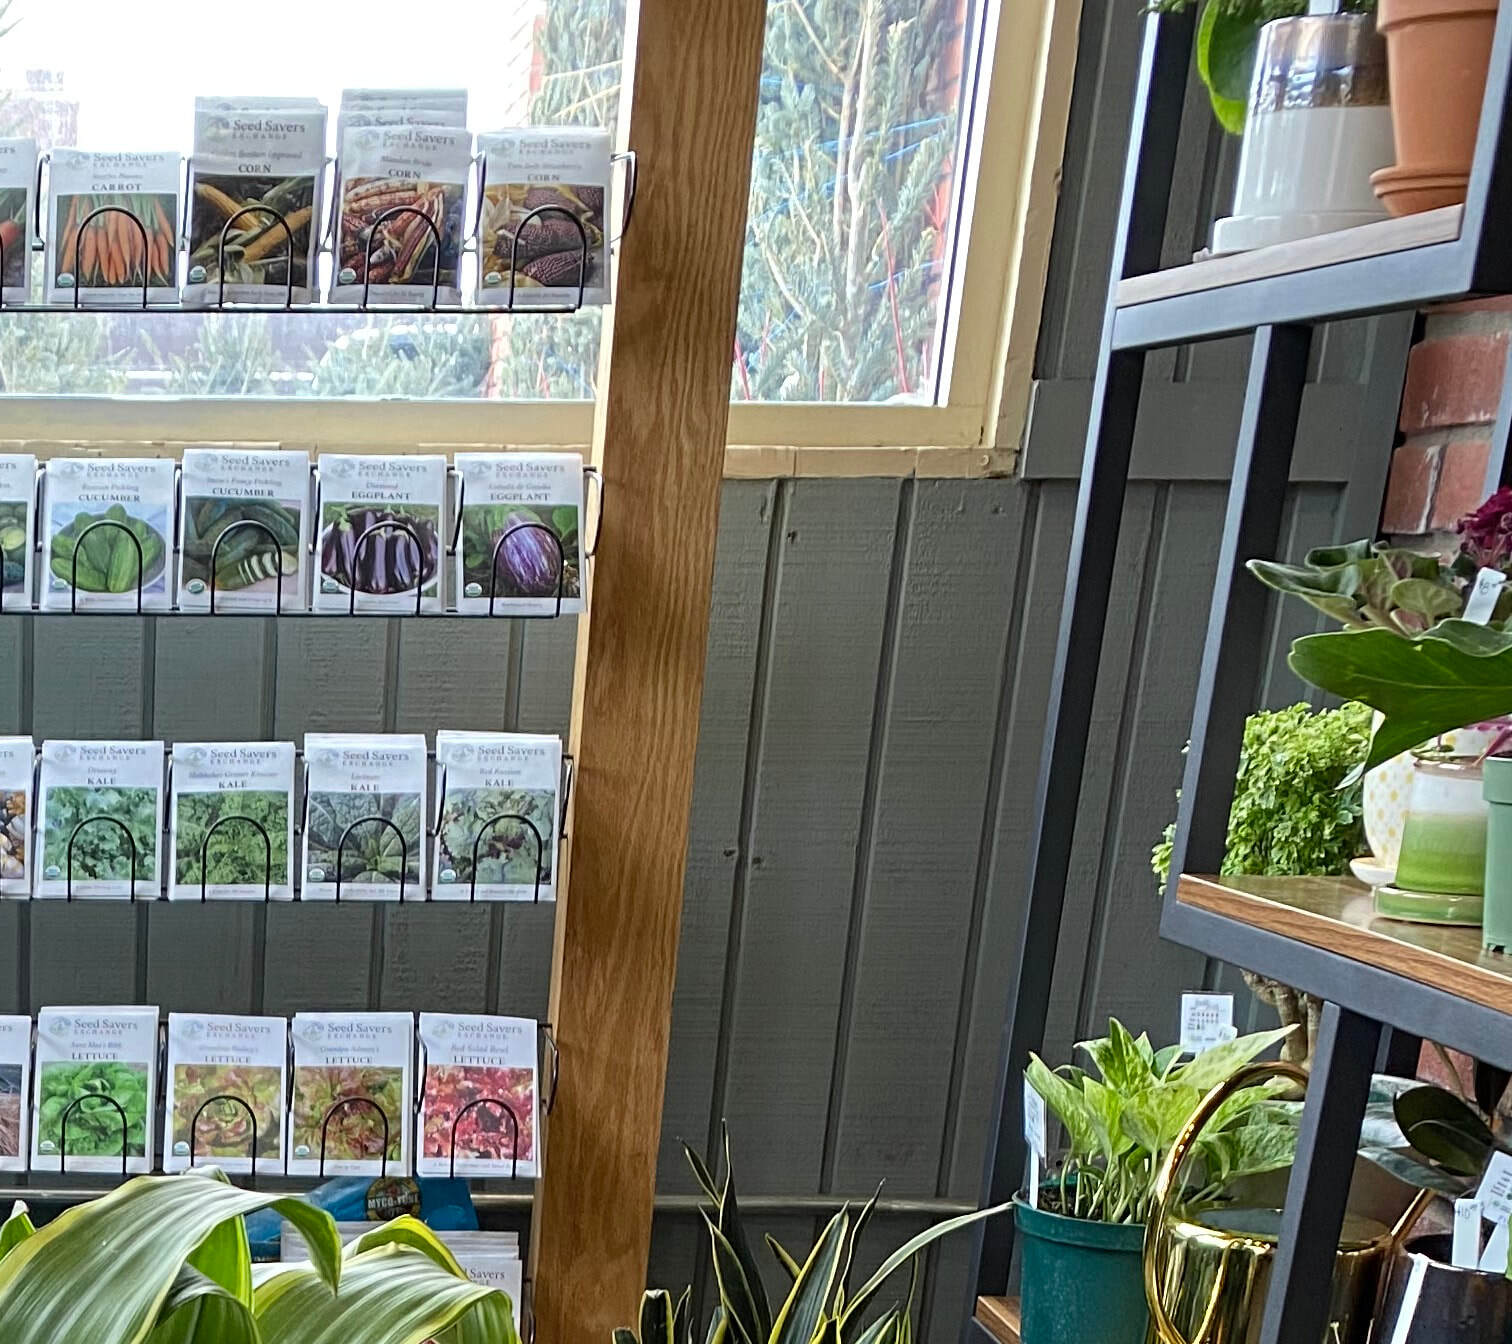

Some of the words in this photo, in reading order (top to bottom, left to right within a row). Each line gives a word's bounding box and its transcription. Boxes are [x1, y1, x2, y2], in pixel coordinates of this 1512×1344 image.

[234, 120, 262, 131] Seed
[265, 120, 305, 133] Savers
[238, 164, 271, 174] CORN
[388, 168, 422, 179] CORN
[92, 183, 142, 191] CARROT
[212, 487, 274, 497] CUCUMBER
[351, 491, 410, 501] EGGPLANT
[78, 495, 141, 503] CUCUMBER
[490, 493, 550, 502] EGGPLANT
[88, 777, 116, 785] KALE
[218, 781, 247, 789] KALE
[485, 779, 513, 787] KALE
[351, 784, 379, 792] KALE
[74, 1019, 99, 1029] Seed
[102, 1019, 138, 1031] Savers
[72, 1053, 117, 1061] LETTUCE
[325, 1057, 373, 1065] LETTUCE
[454, 1056, 503, 1065] LETTUCE
[470, 1269, 506, 1282] Savers
